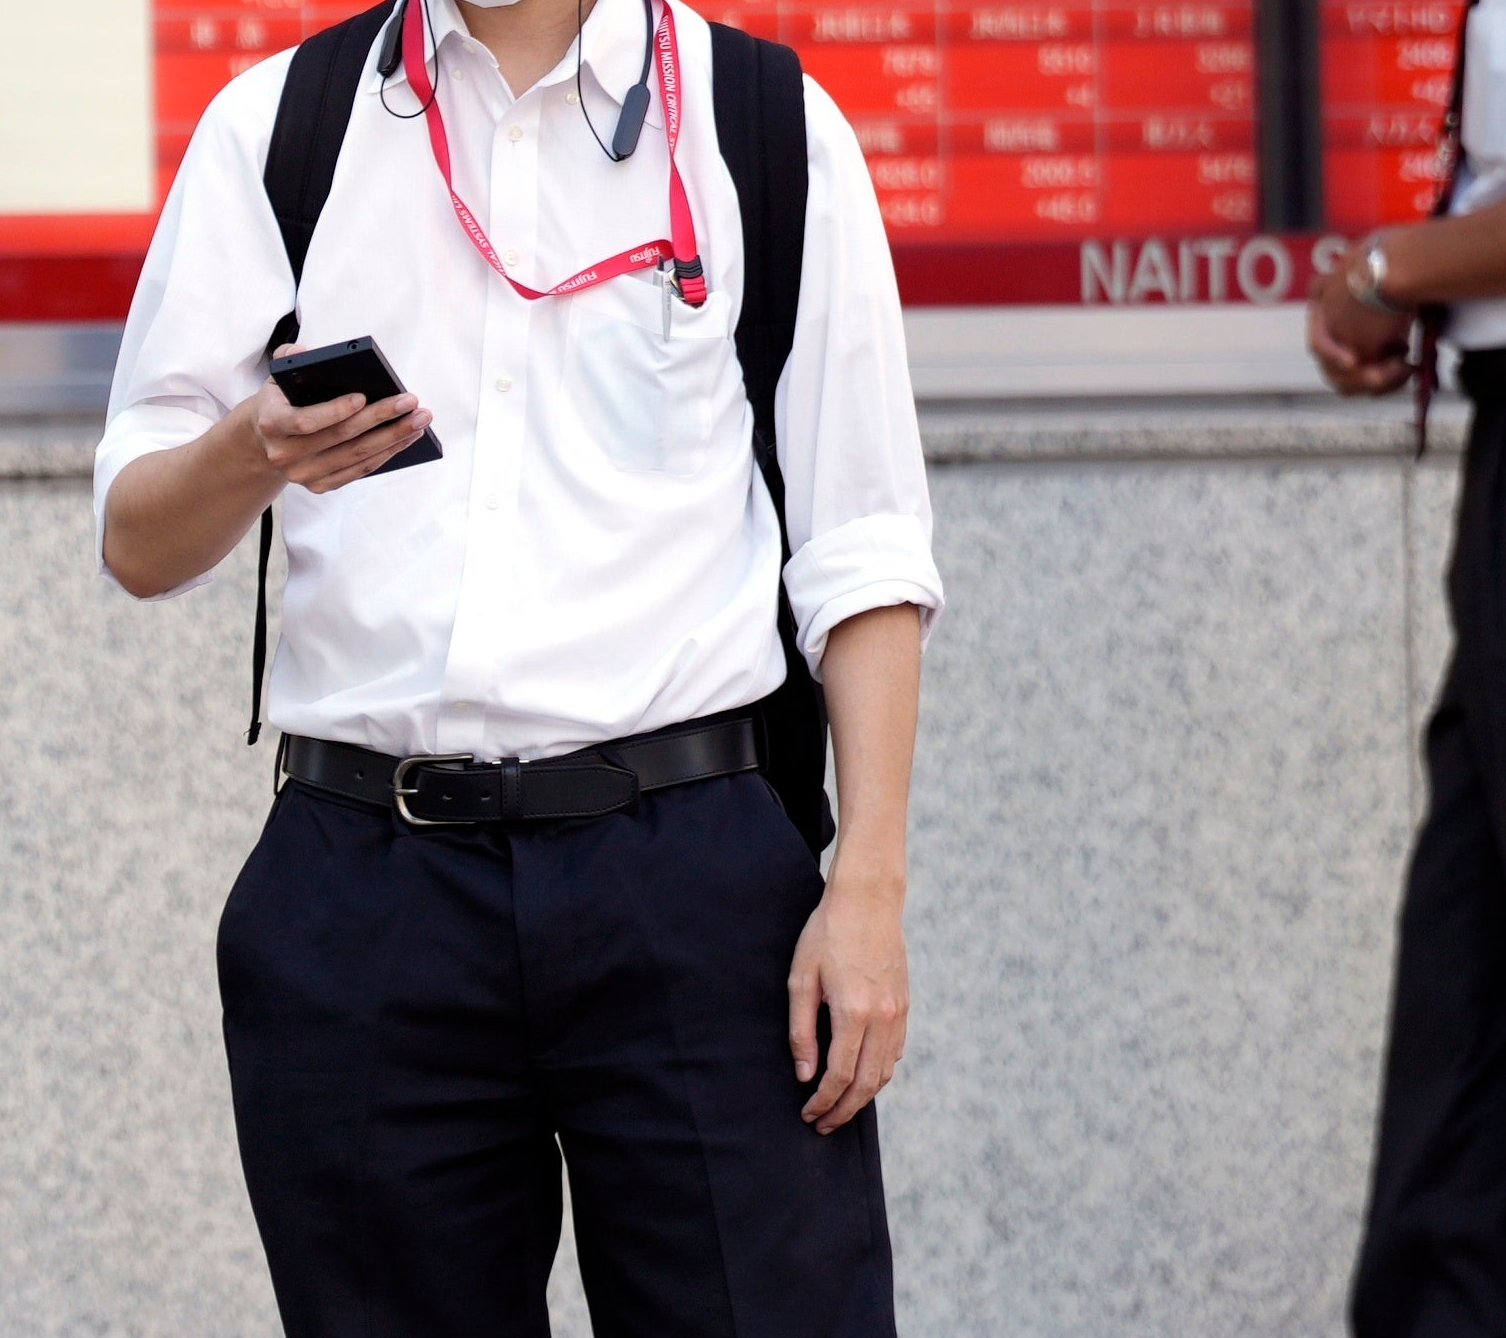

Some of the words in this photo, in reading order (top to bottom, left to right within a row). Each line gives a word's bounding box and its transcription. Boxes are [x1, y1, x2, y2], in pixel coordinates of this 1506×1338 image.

[660, 51, 676, 93] MISSION
[665, 92, 678, 134] CRITICAL
[459, 208, 489, 249] SYSTEMS
[629, 245, 661, 264] FUJITSU
[1079, 235, 1294, 306] NAITO
[557, 270, 598, 293] FUJITSU
